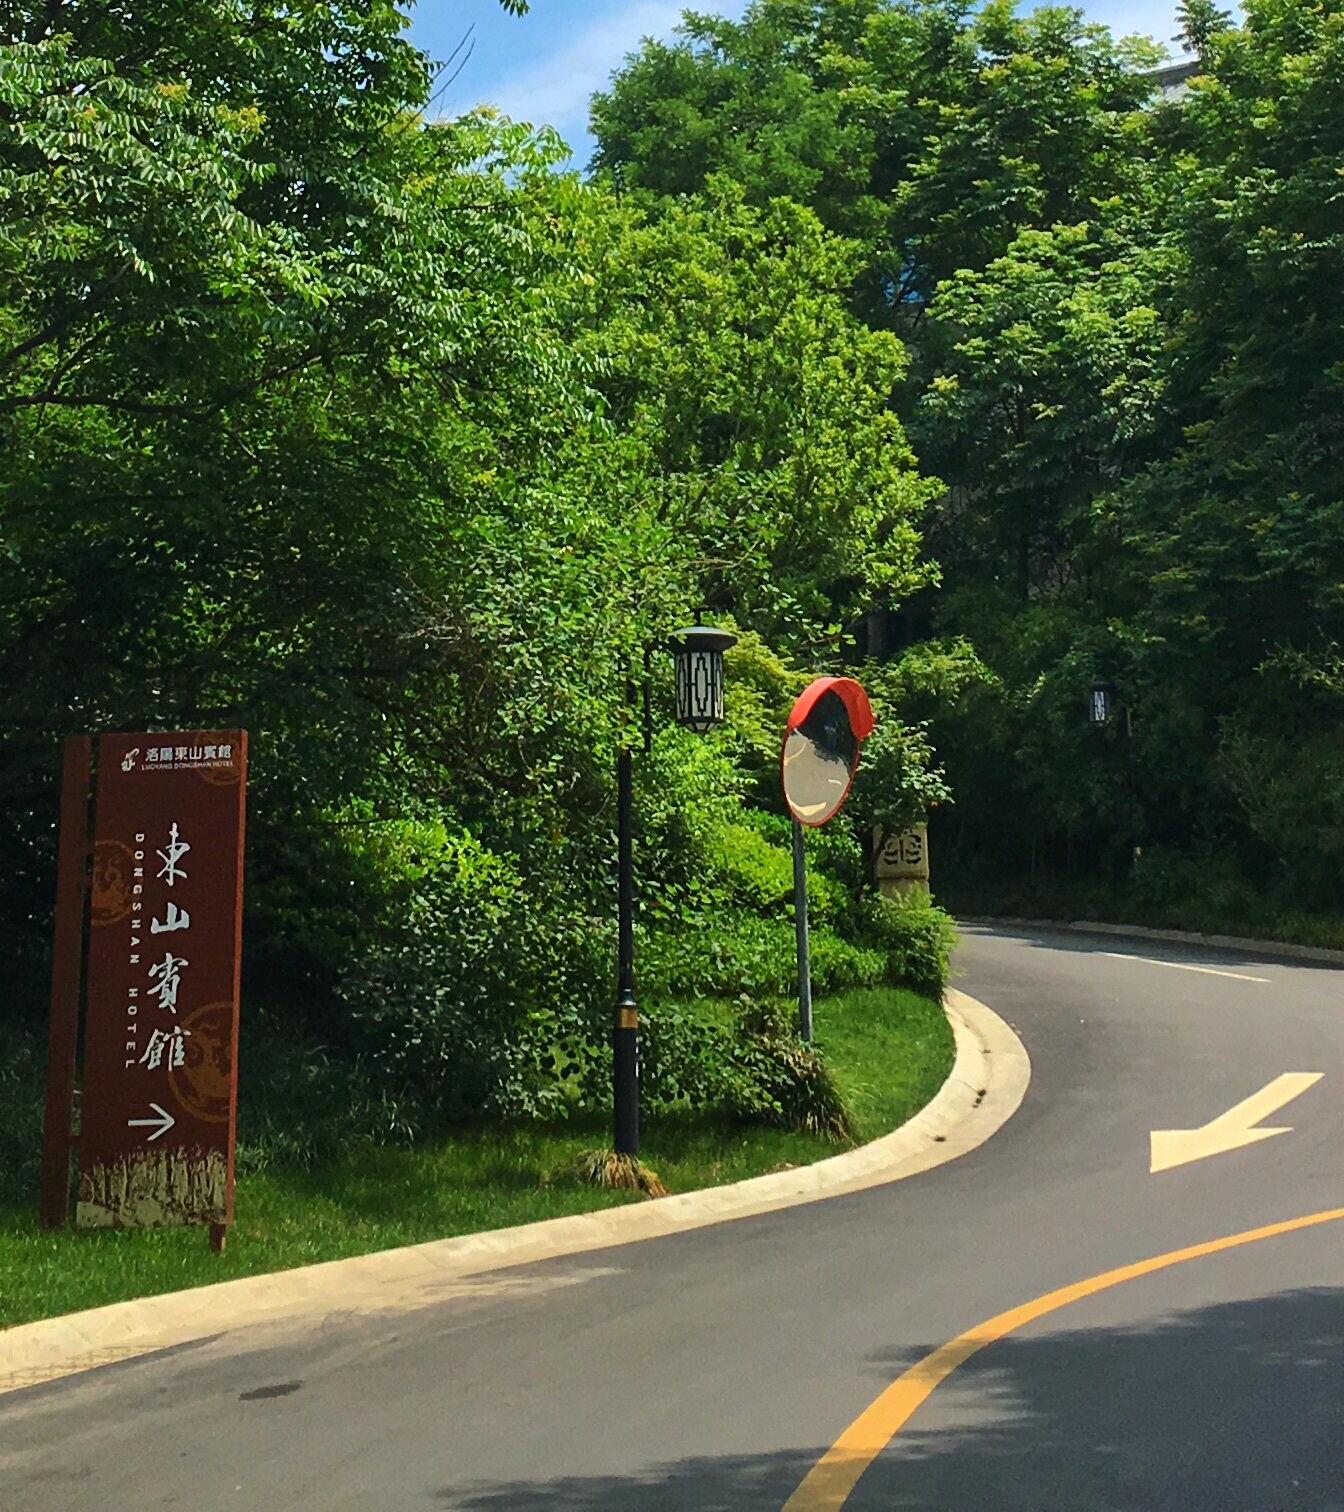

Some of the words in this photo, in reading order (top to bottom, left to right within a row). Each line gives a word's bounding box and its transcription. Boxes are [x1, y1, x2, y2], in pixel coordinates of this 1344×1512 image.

[145, 745, 232, 762] 洛陽東山賓館
[212, 760, 234, 768] HOTEL
[129, 833, 145, 964] DONGSHAN
[125, 988, 139, 1069] HOTEL
